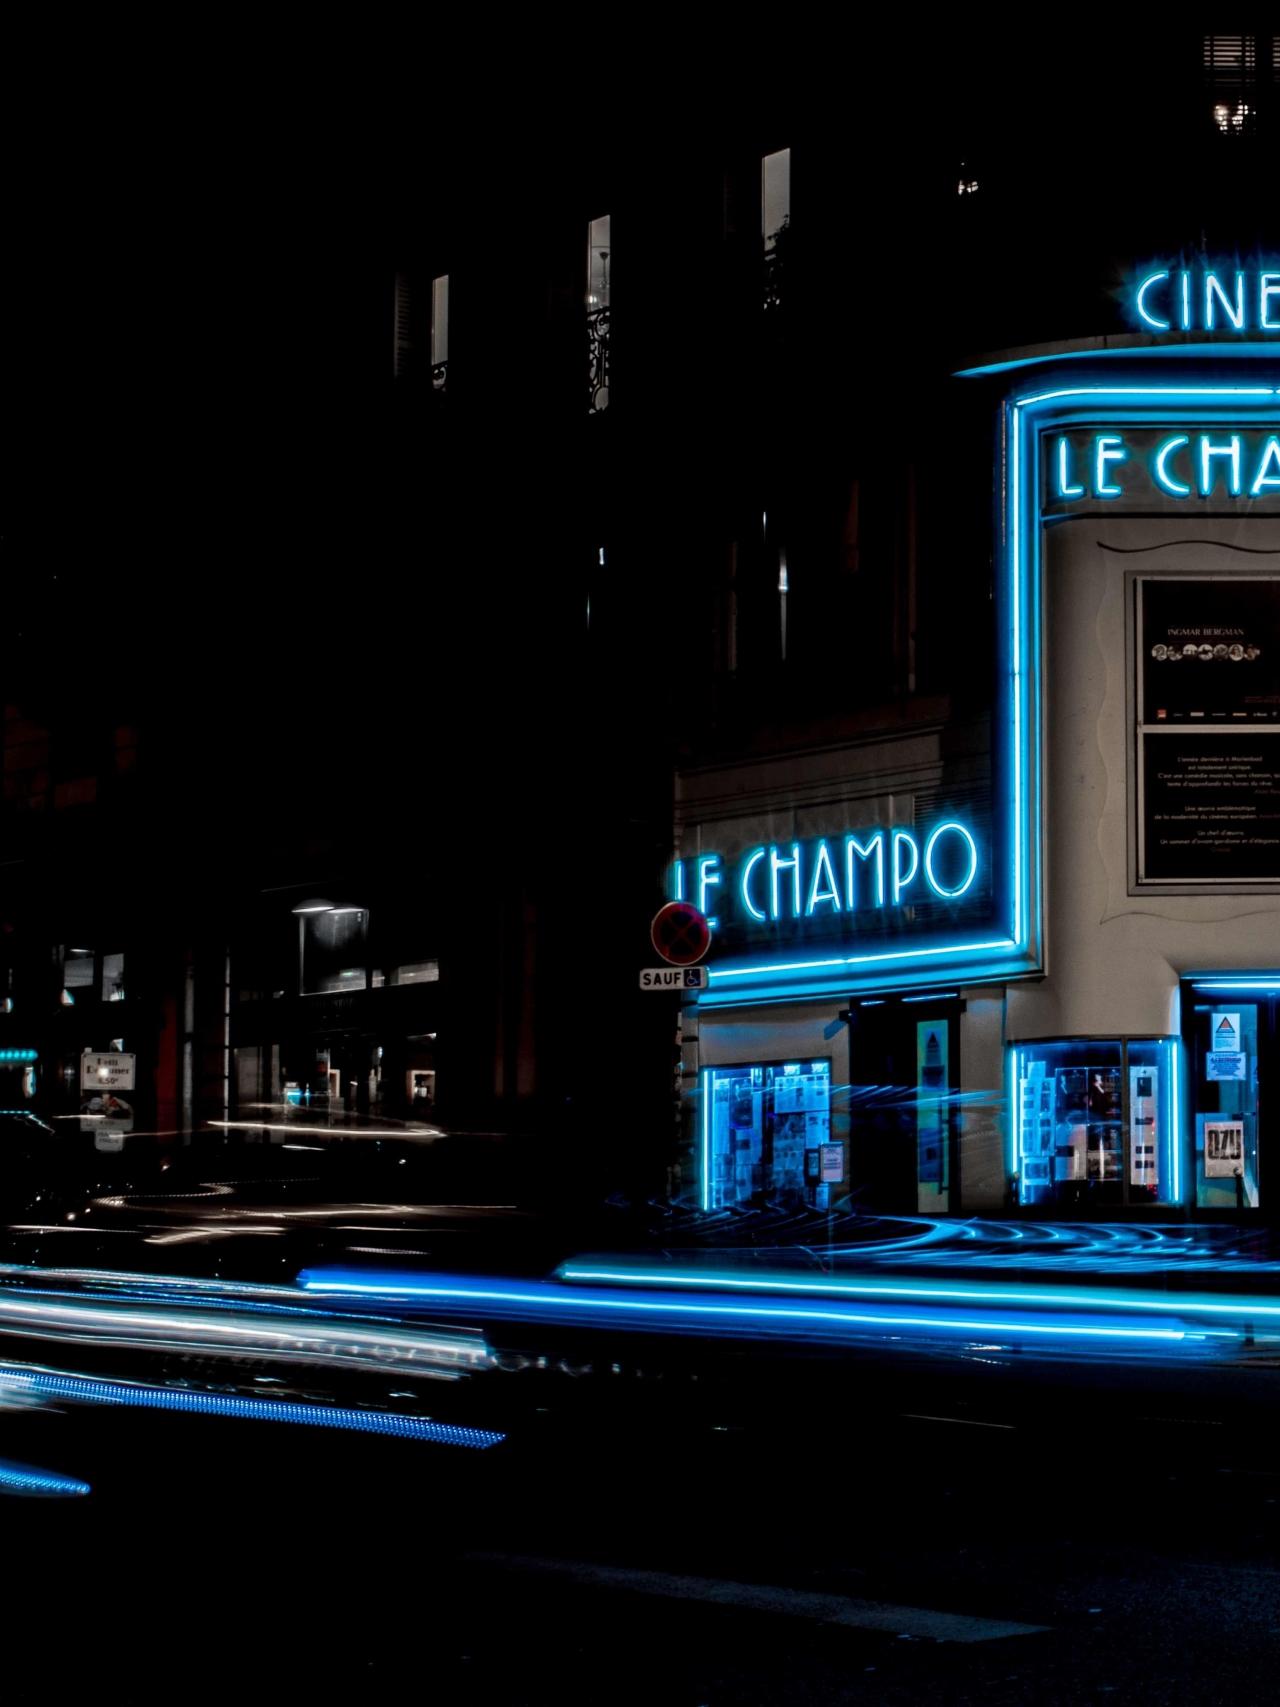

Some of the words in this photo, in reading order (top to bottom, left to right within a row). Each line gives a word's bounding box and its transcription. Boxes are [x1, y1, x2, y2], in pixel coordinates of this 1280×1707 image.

[1058, 435, 1126, 498] LE
[741, 822, 979, 922] CHAMPO
[643, 972, 682, 986] SAUF
